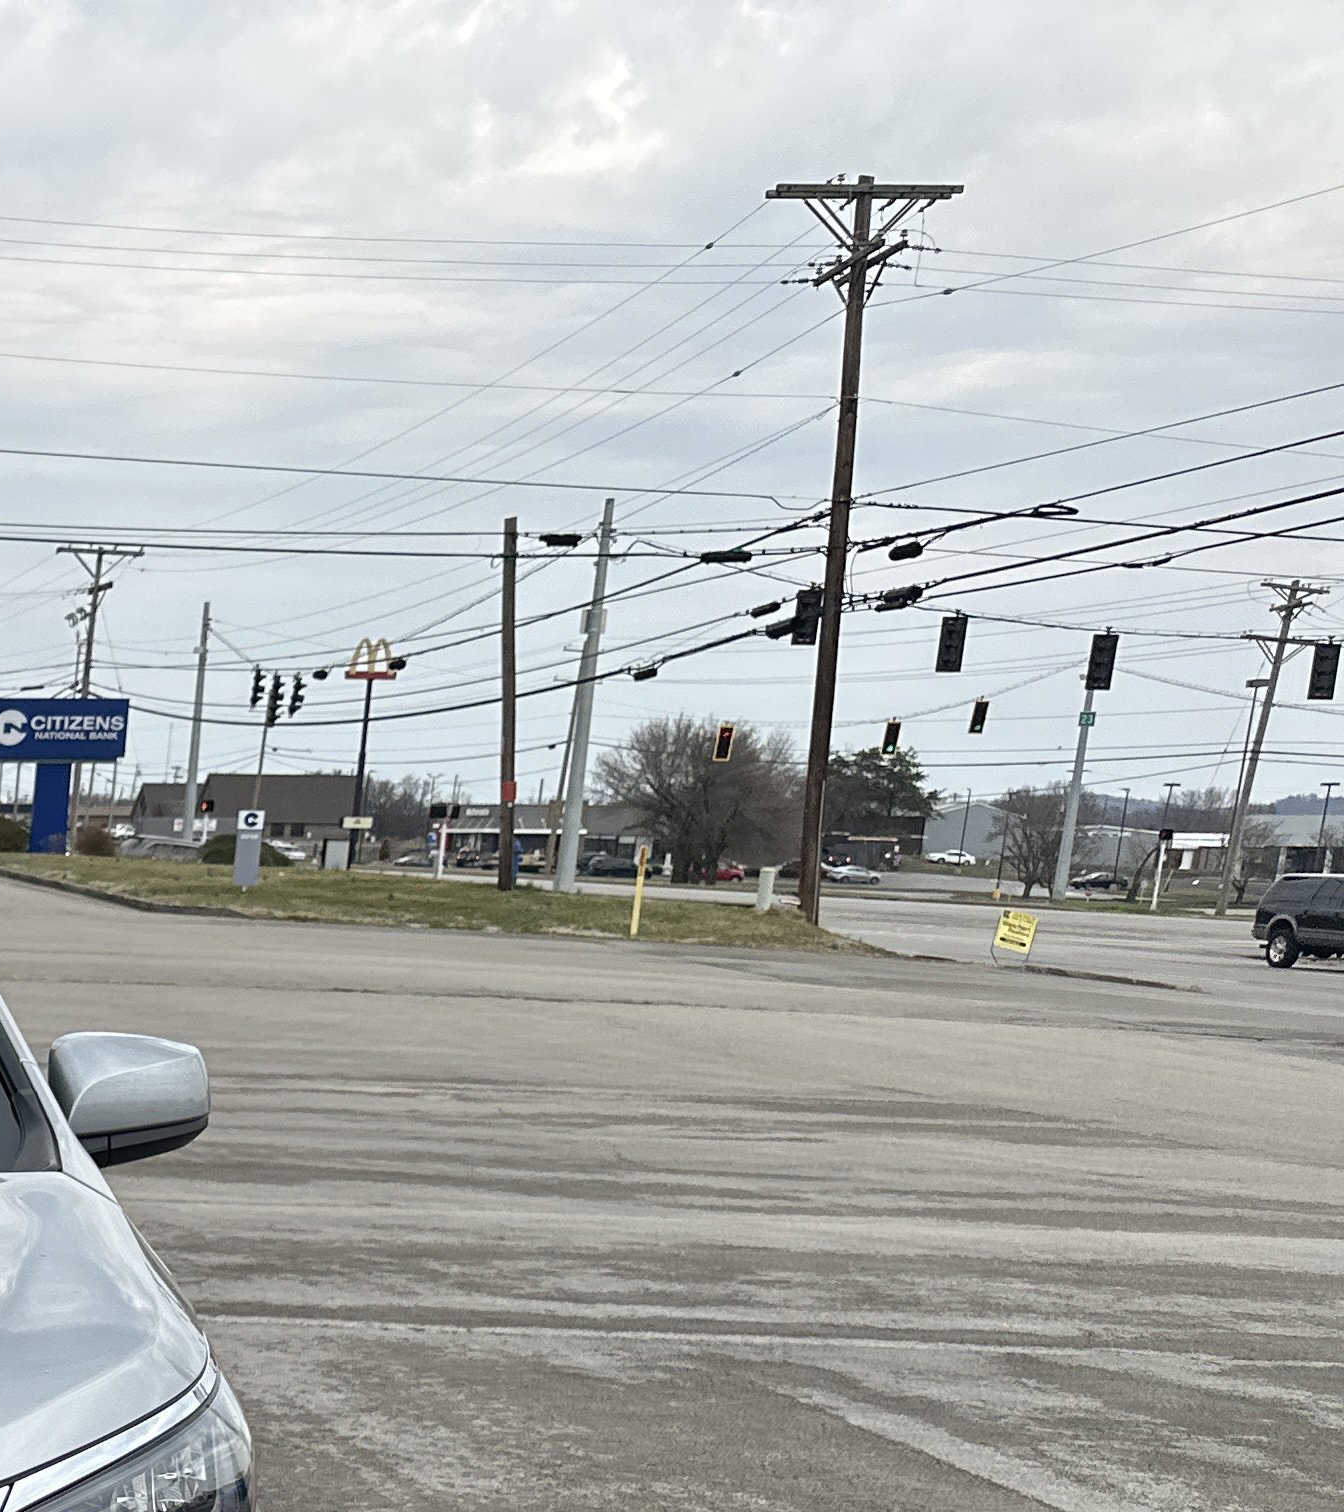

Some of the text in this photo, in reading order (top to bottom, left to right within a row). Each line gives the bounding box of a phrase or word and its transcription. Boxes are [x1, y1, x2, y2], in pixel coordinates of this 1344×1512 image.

[30, 715, 125, 732] CITIZENS
[34, 731, 119, 741] NATIONAL BANK
